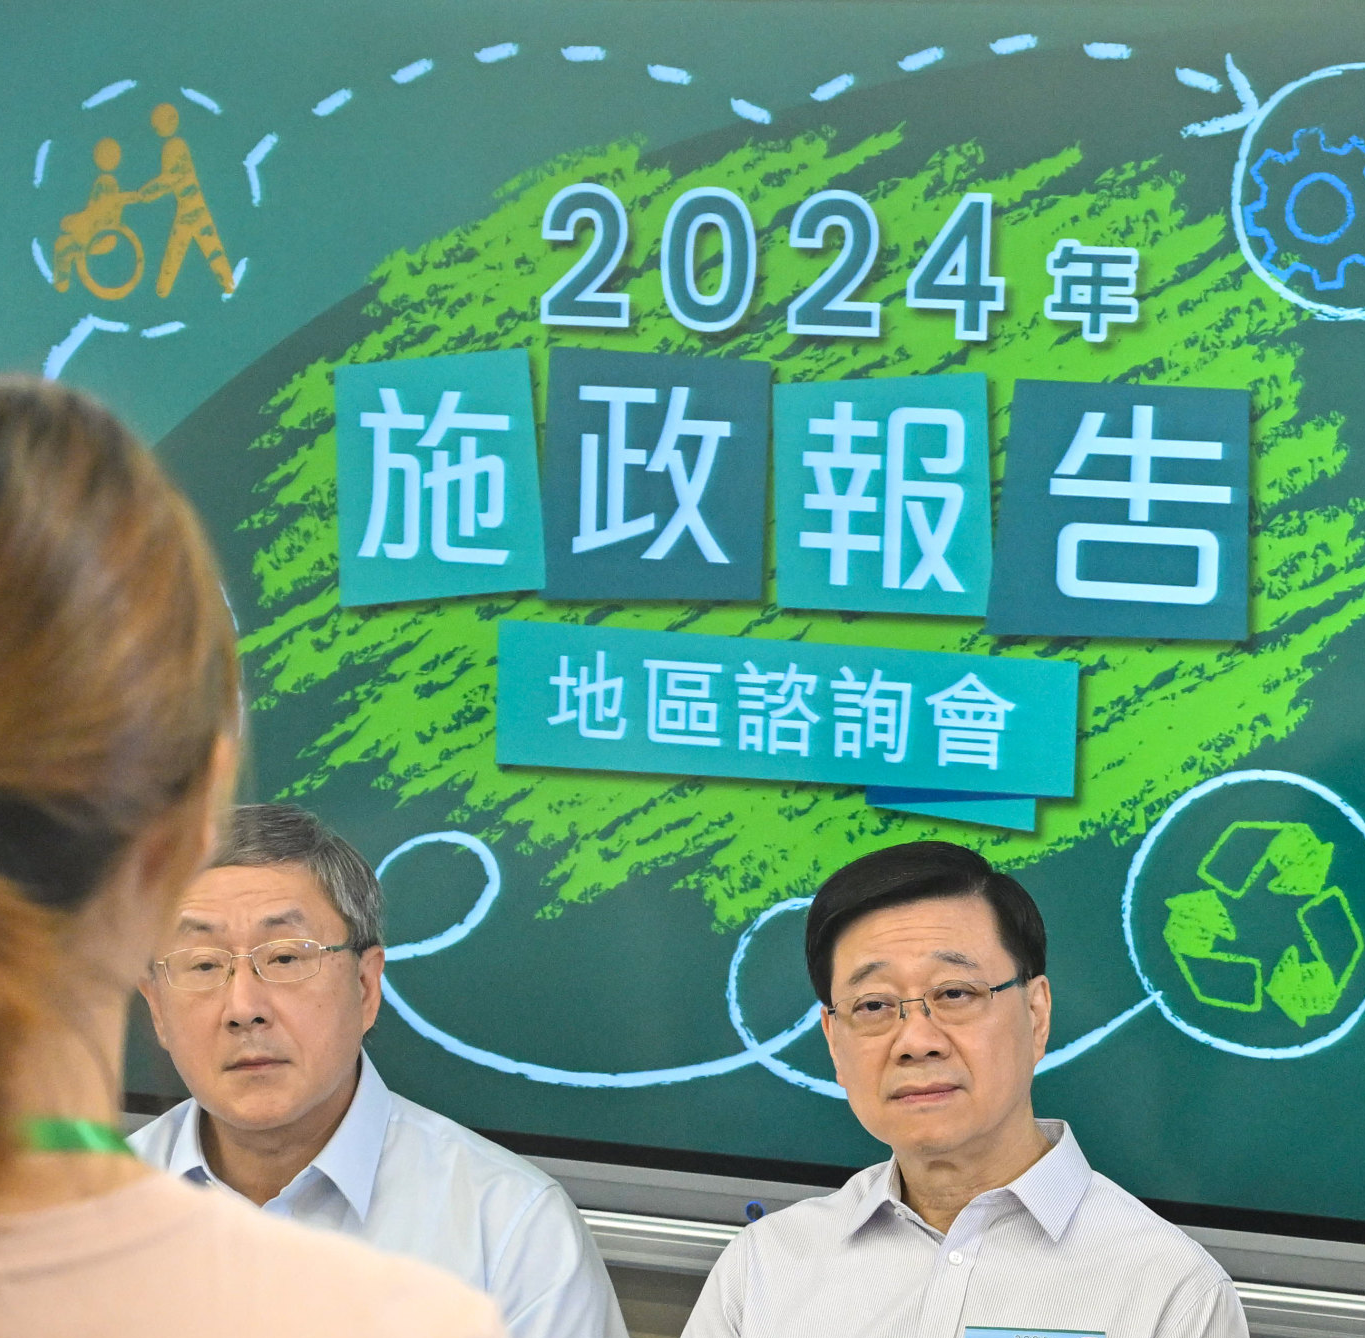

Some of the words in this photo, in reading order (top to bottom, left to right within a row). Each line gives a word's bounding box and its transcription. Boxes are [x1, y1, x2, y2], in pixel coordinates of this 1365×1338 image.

[540, 181, 1140, 342] 2024年
[356, 384, 1233, 605] 施政報告
[546, 650, 1016, 770] 地區諮詢會
